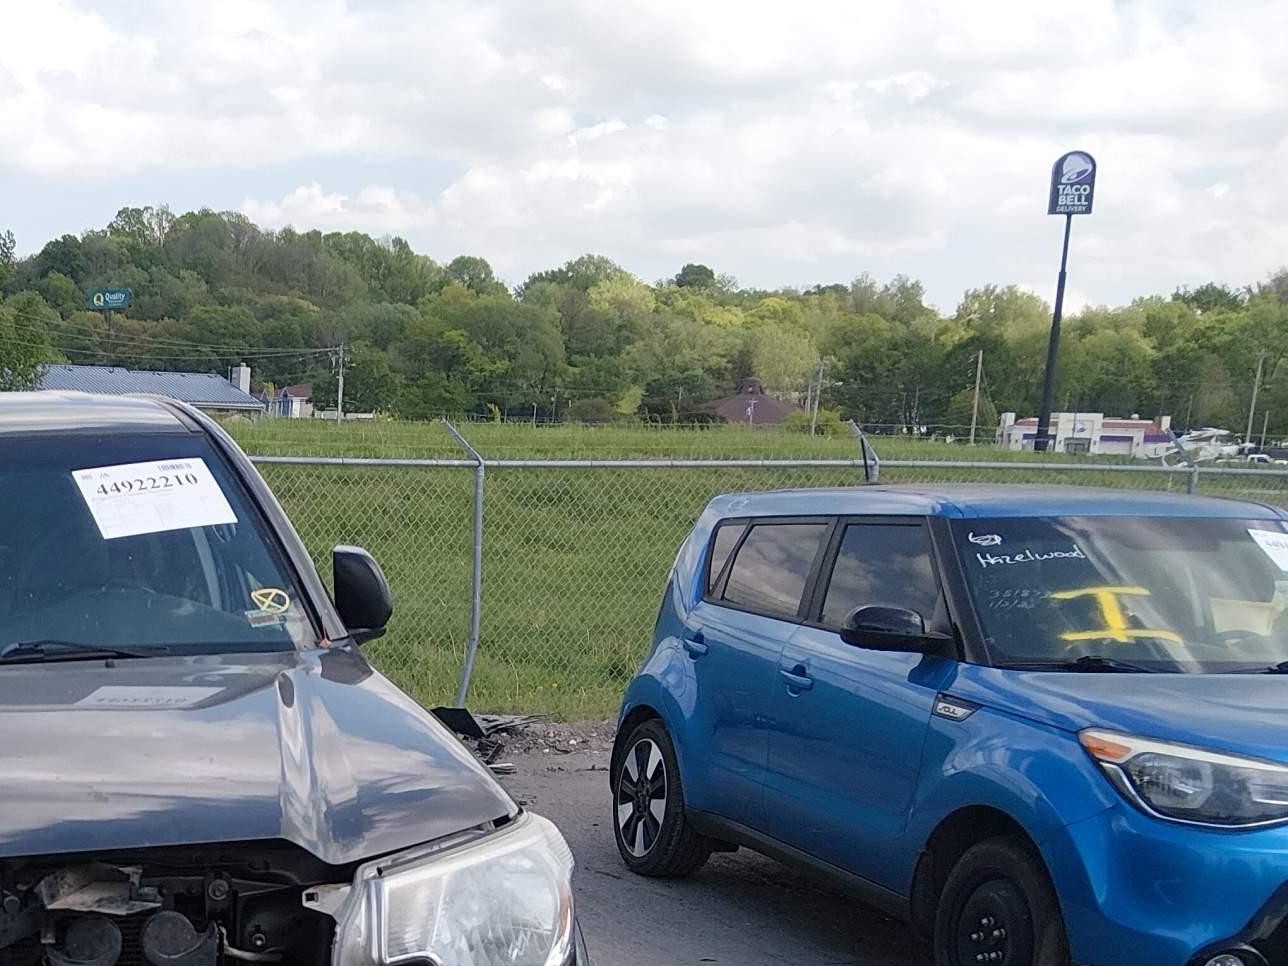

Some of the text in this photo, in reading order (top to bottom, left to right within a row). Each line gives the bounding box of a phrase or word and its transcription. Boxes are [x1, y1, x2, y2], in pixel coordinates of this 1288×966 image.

[1057, 184, 1090, 195] TACO
[1058, 194, 1089, 205] BELL
[105, 292, 126, 303] Quality
[96, 472, 198, 496] 44922210
[976, 544, 1087, 568] Hazelwood
